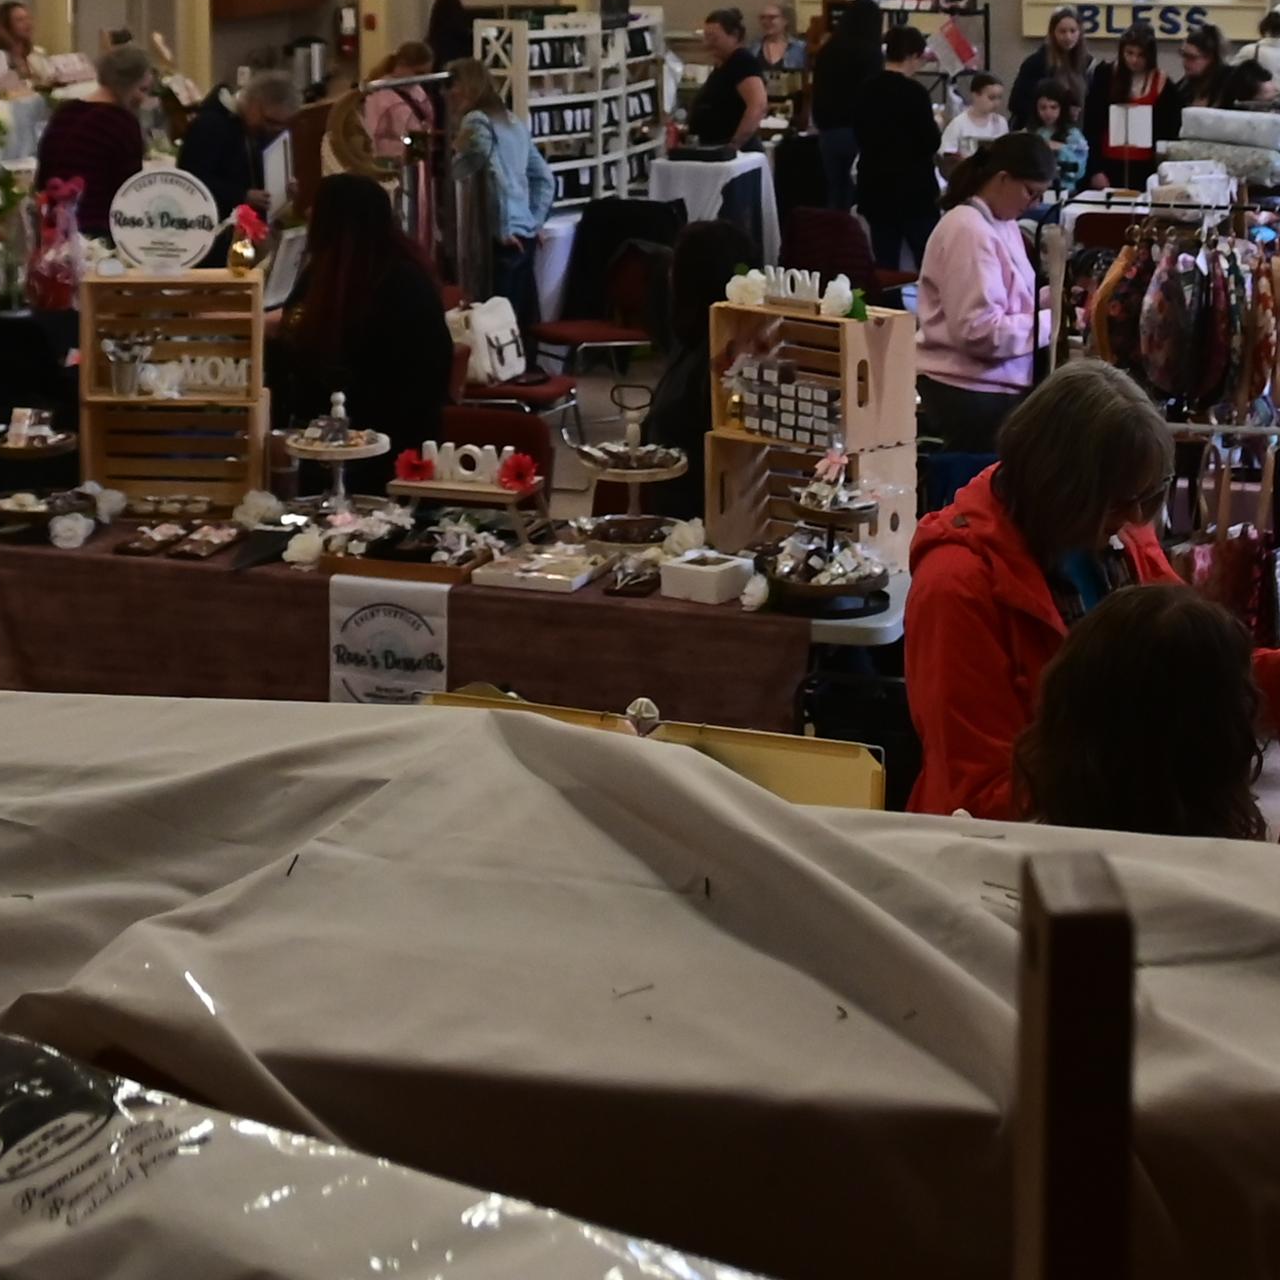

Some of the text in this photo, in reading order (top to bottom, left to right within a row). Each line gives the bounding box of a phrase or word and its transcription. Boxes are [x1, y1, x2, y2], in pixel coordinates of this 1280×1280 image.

[1079, 4, 1208, 35] BLESS
[112, 210, 215, 232] Rose's Desserts
[764, 264, 821, 302] MOM
[181, 354, 249, 387] MOM
[422, 440, 516, 483] MOM
[333, 644, 444, 673] Rose's Desserts
